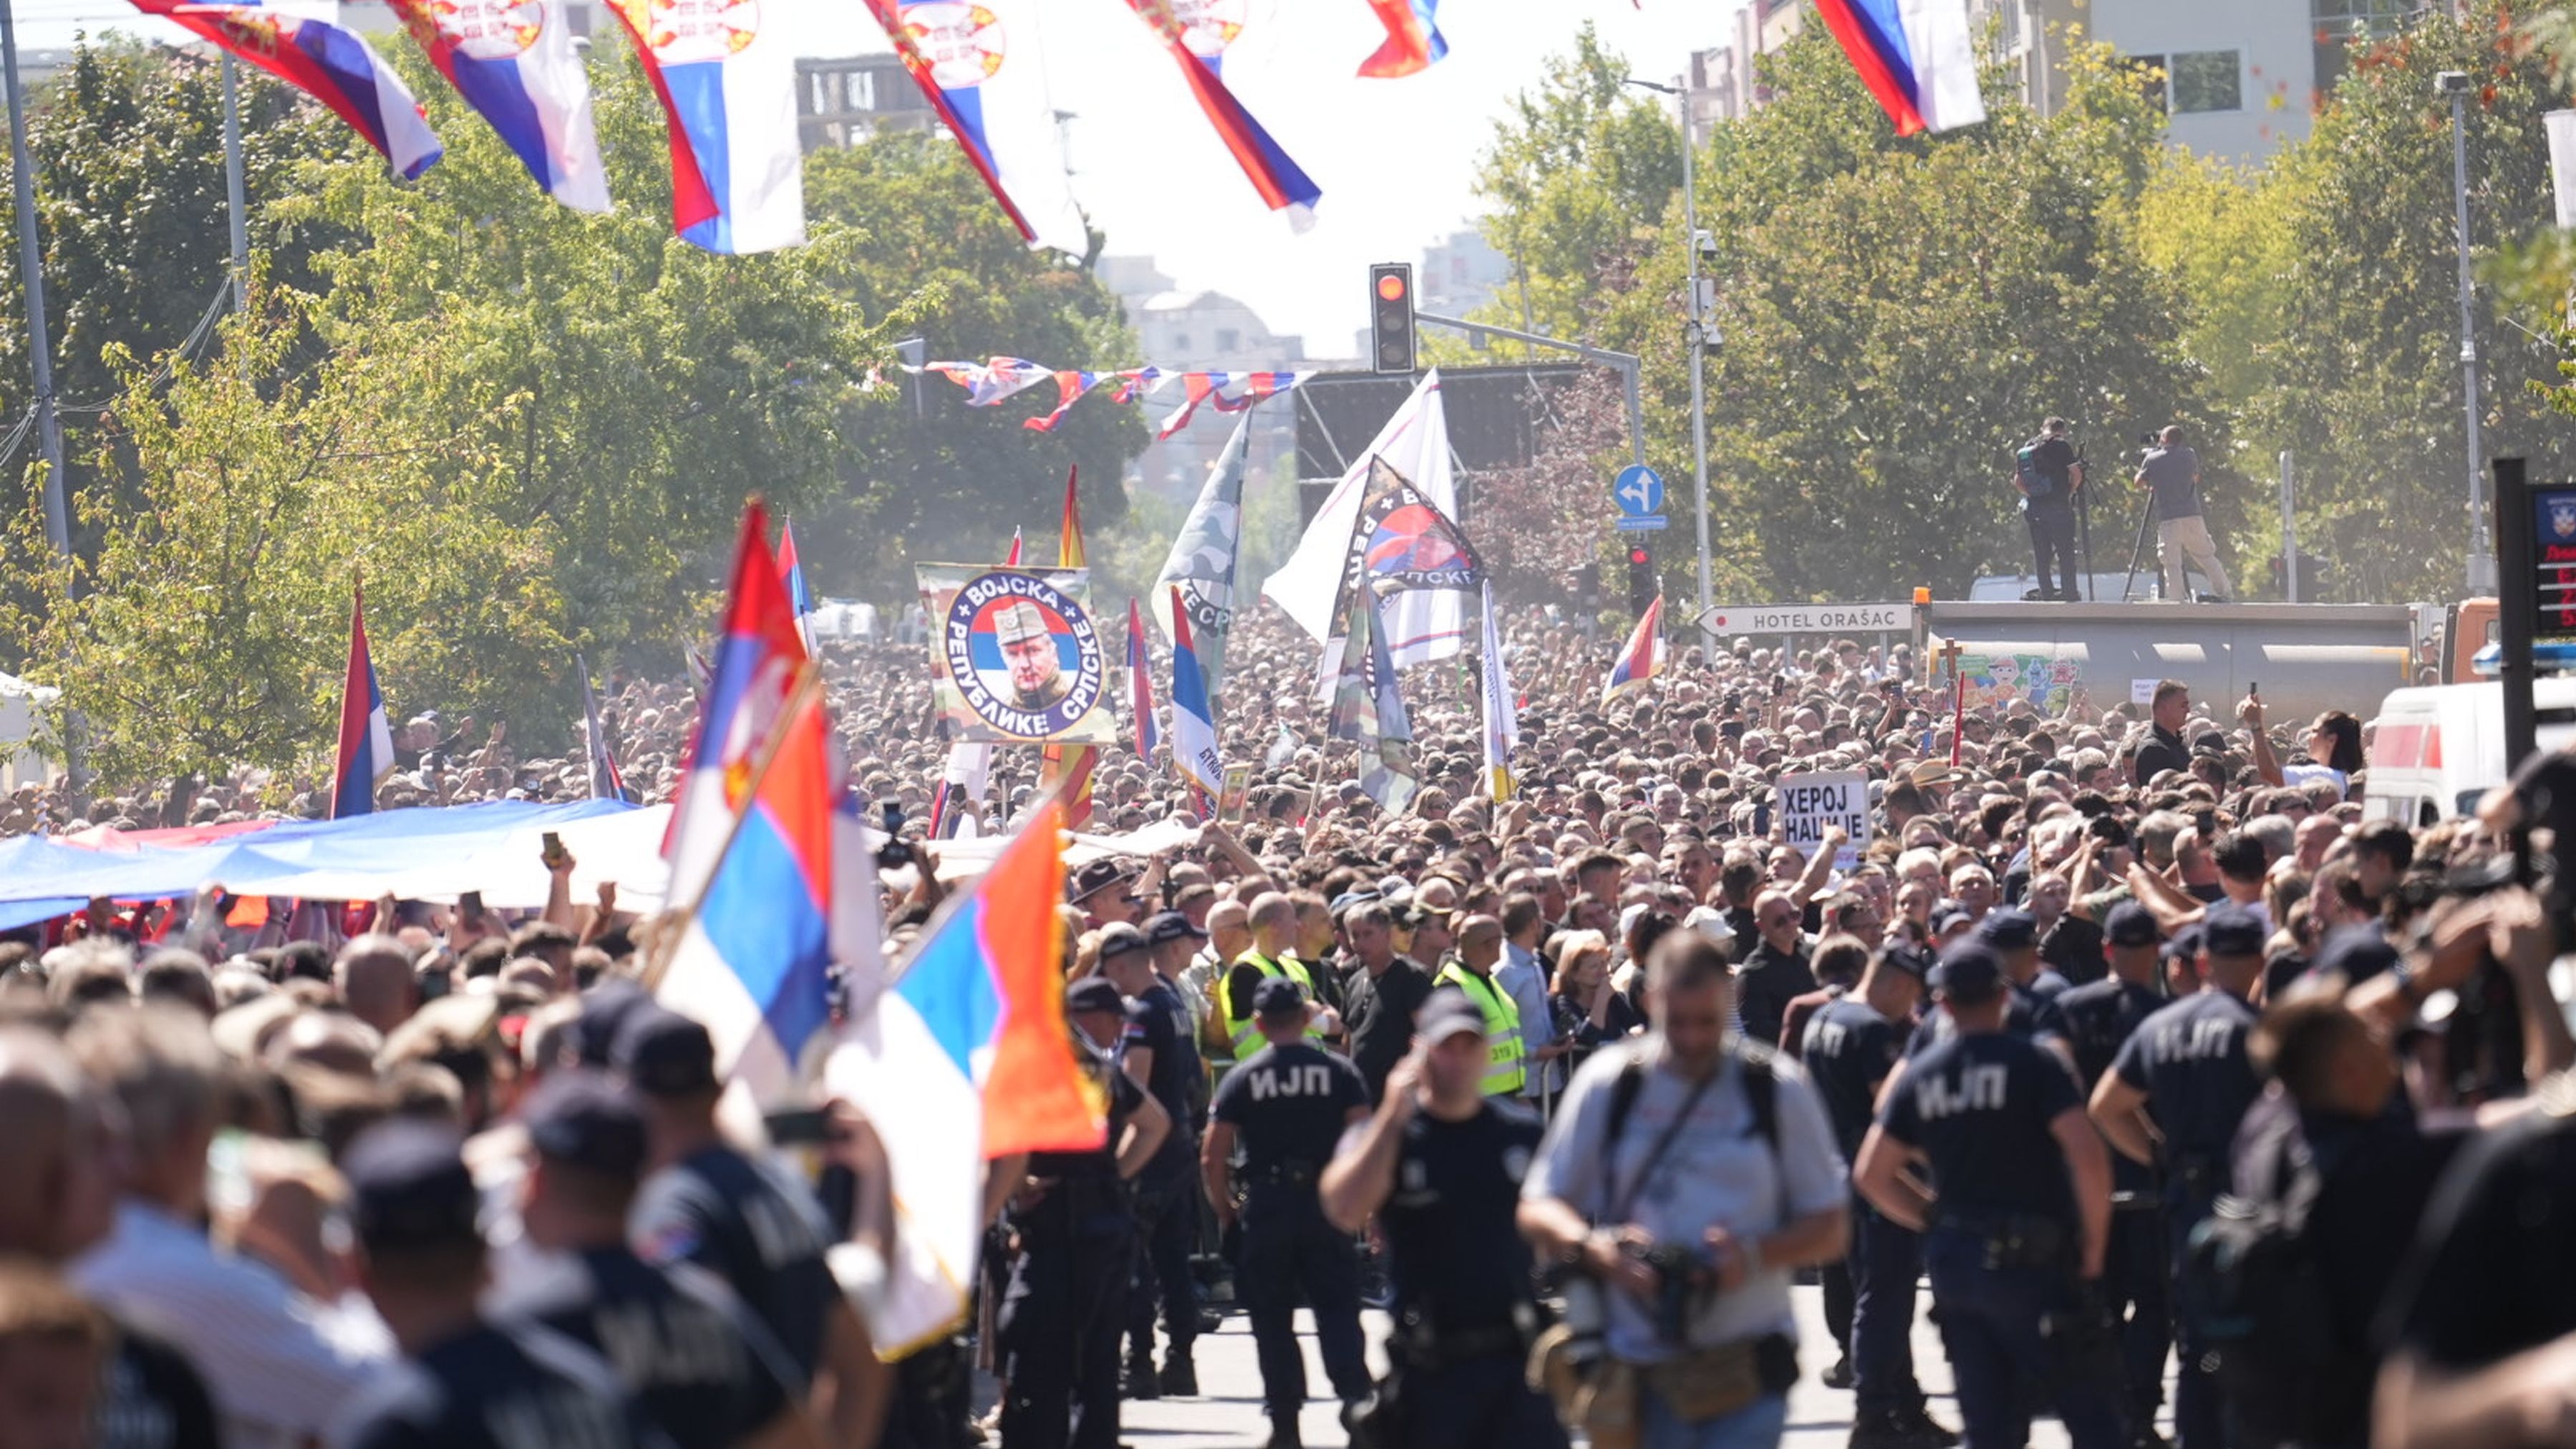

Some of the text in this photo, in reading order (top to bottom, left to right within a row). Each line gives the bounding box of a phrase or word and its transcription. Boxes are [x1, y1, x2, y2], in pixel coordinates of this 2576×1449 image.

[966, 576, 1058, 609] ВОЈСКА
[1755, 609, 1895, 628] HOTEL ORAŠAC
[949, 619, 1100, 735] РЕПУБЛИКЕ СРПСКЕ
[1784, 785, 1846, 815] ХЕРОЈ
[1250, 1065, 1331, 1101] ИЈП
[1915, 1064, 2008, 1121] ИЈП
